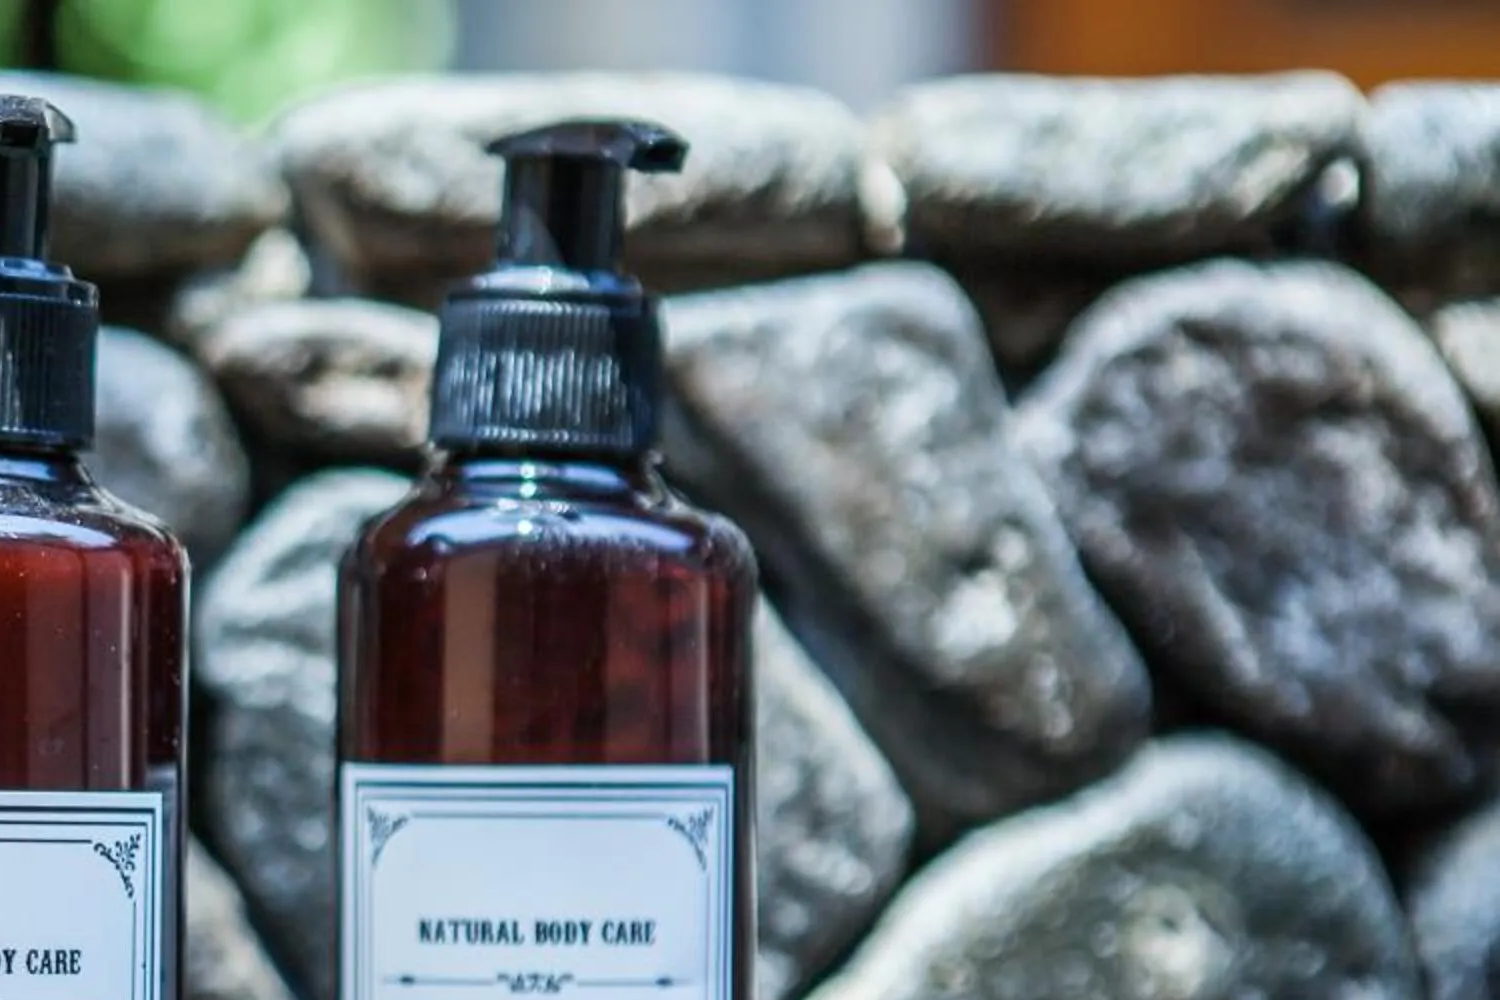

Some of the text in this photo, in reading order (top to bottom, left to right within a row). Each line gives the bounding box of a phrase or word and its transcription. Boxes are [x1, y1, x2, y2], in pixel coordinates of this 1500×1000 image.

[419, 920, 656, 945] NATURAL BODY CARE
[26, 949, 81, 975] CARE
